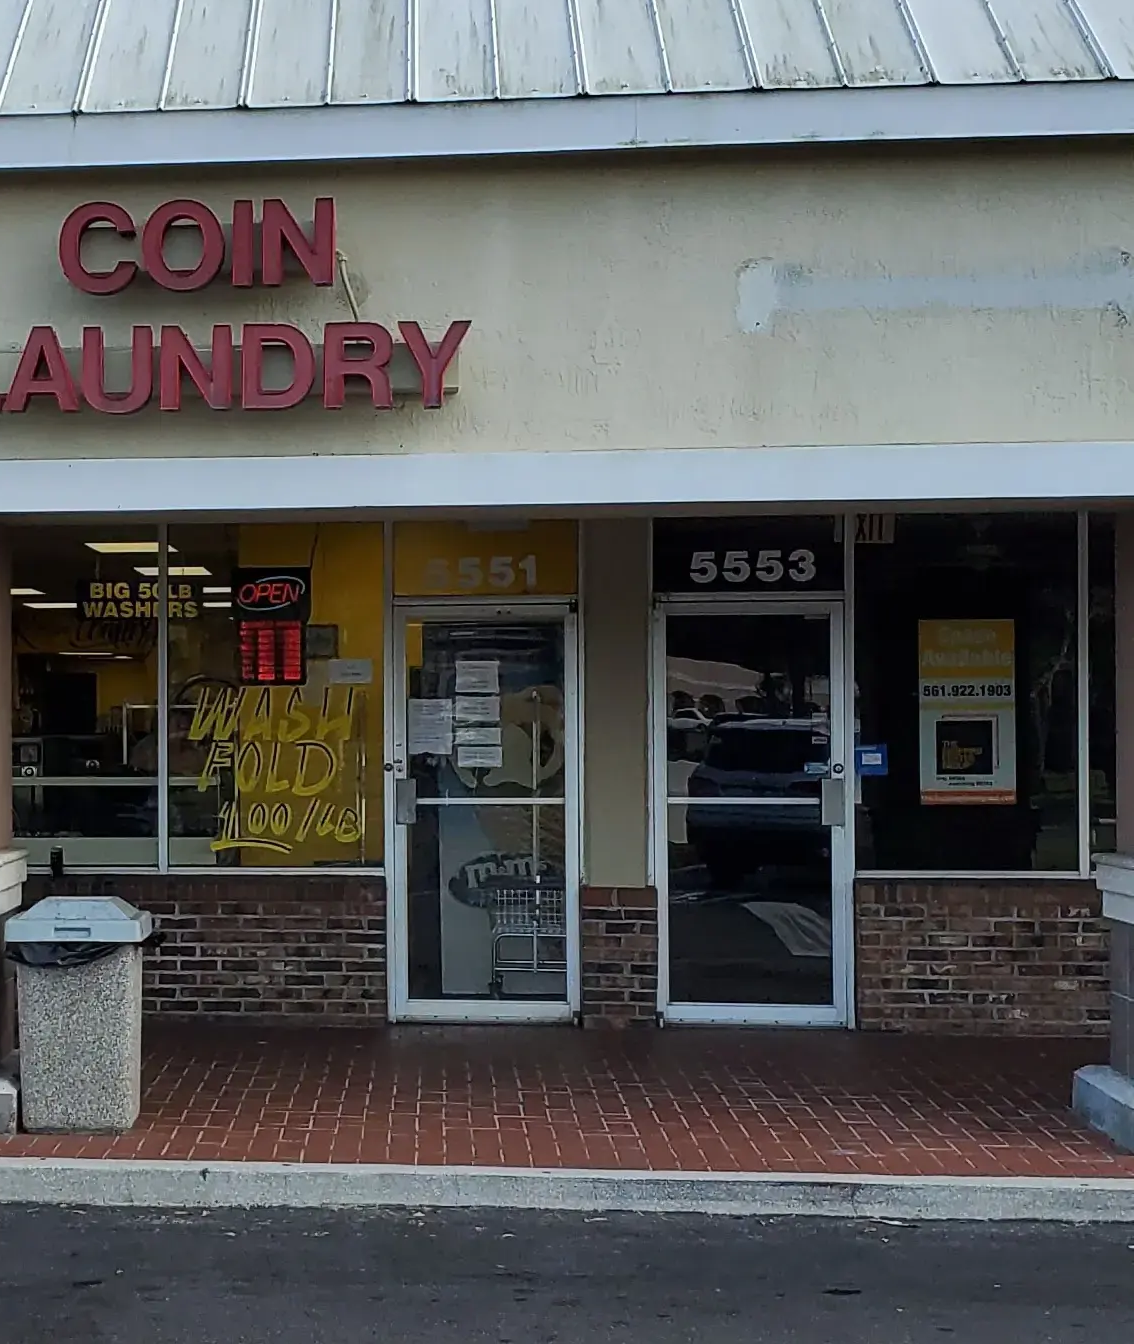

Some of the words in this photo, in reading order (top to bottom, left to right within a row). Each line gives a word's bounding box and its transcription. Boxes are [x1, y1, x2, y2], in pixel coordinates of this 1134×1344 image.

[58, 197, 336, 296] COIN
[690, 549, 816, 583] 5553
[89, 582, 131, 600] BIG
[239, 583, 300, 605] OPEN
[922, 684, 1012, 697] 561.922.1903
[187, 686, 355, 742] WASH
[197, 739, 338, 797] FOLD
